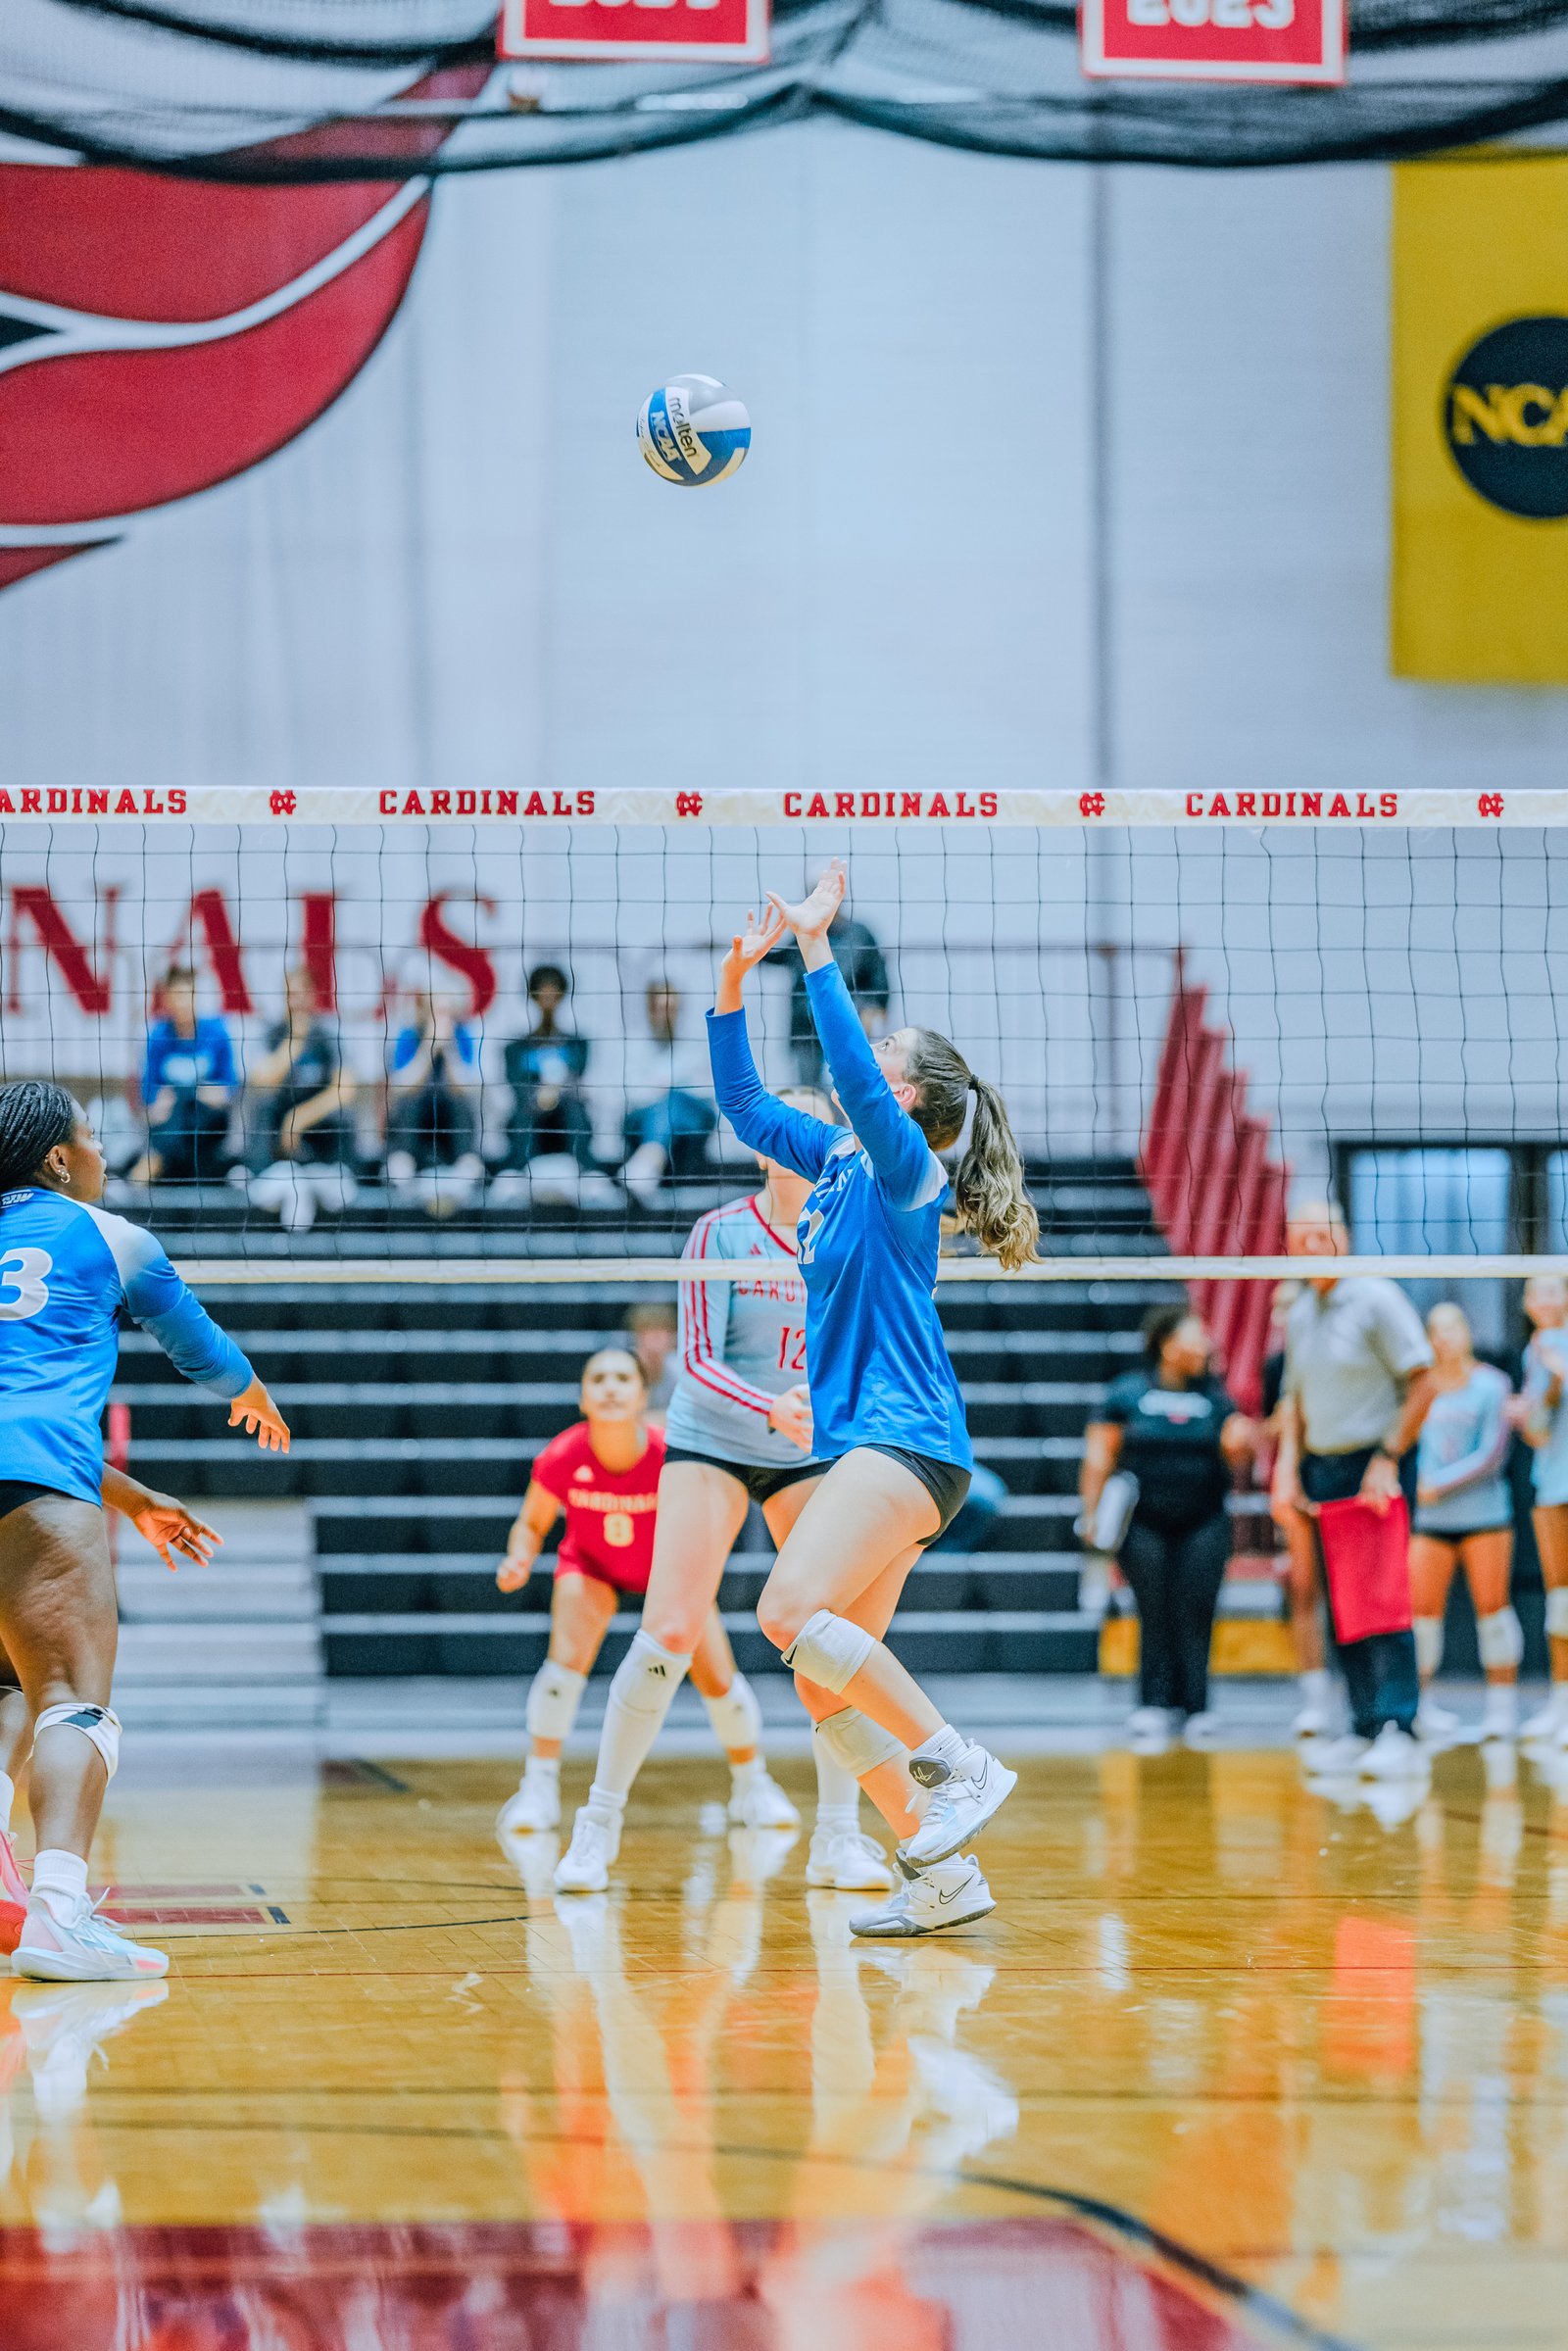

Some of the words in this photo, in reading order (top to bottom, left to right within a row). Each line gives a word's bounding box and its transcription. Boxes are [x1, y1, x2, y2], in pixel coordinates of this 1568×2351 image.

[668, 396, 697, 458] molten
[1453, 383, 1568, 447] NC
[0, 788, 187, 814] ARDINALS
[379, 790, 595, 815] CARDINALS
[784, 792, 998, 817] CARDINALS
[1186, 792, 1397, 817] CARDINALS
[0, 1247, 53, 1321] 3
[778, 1326, 806, 1370] 12
